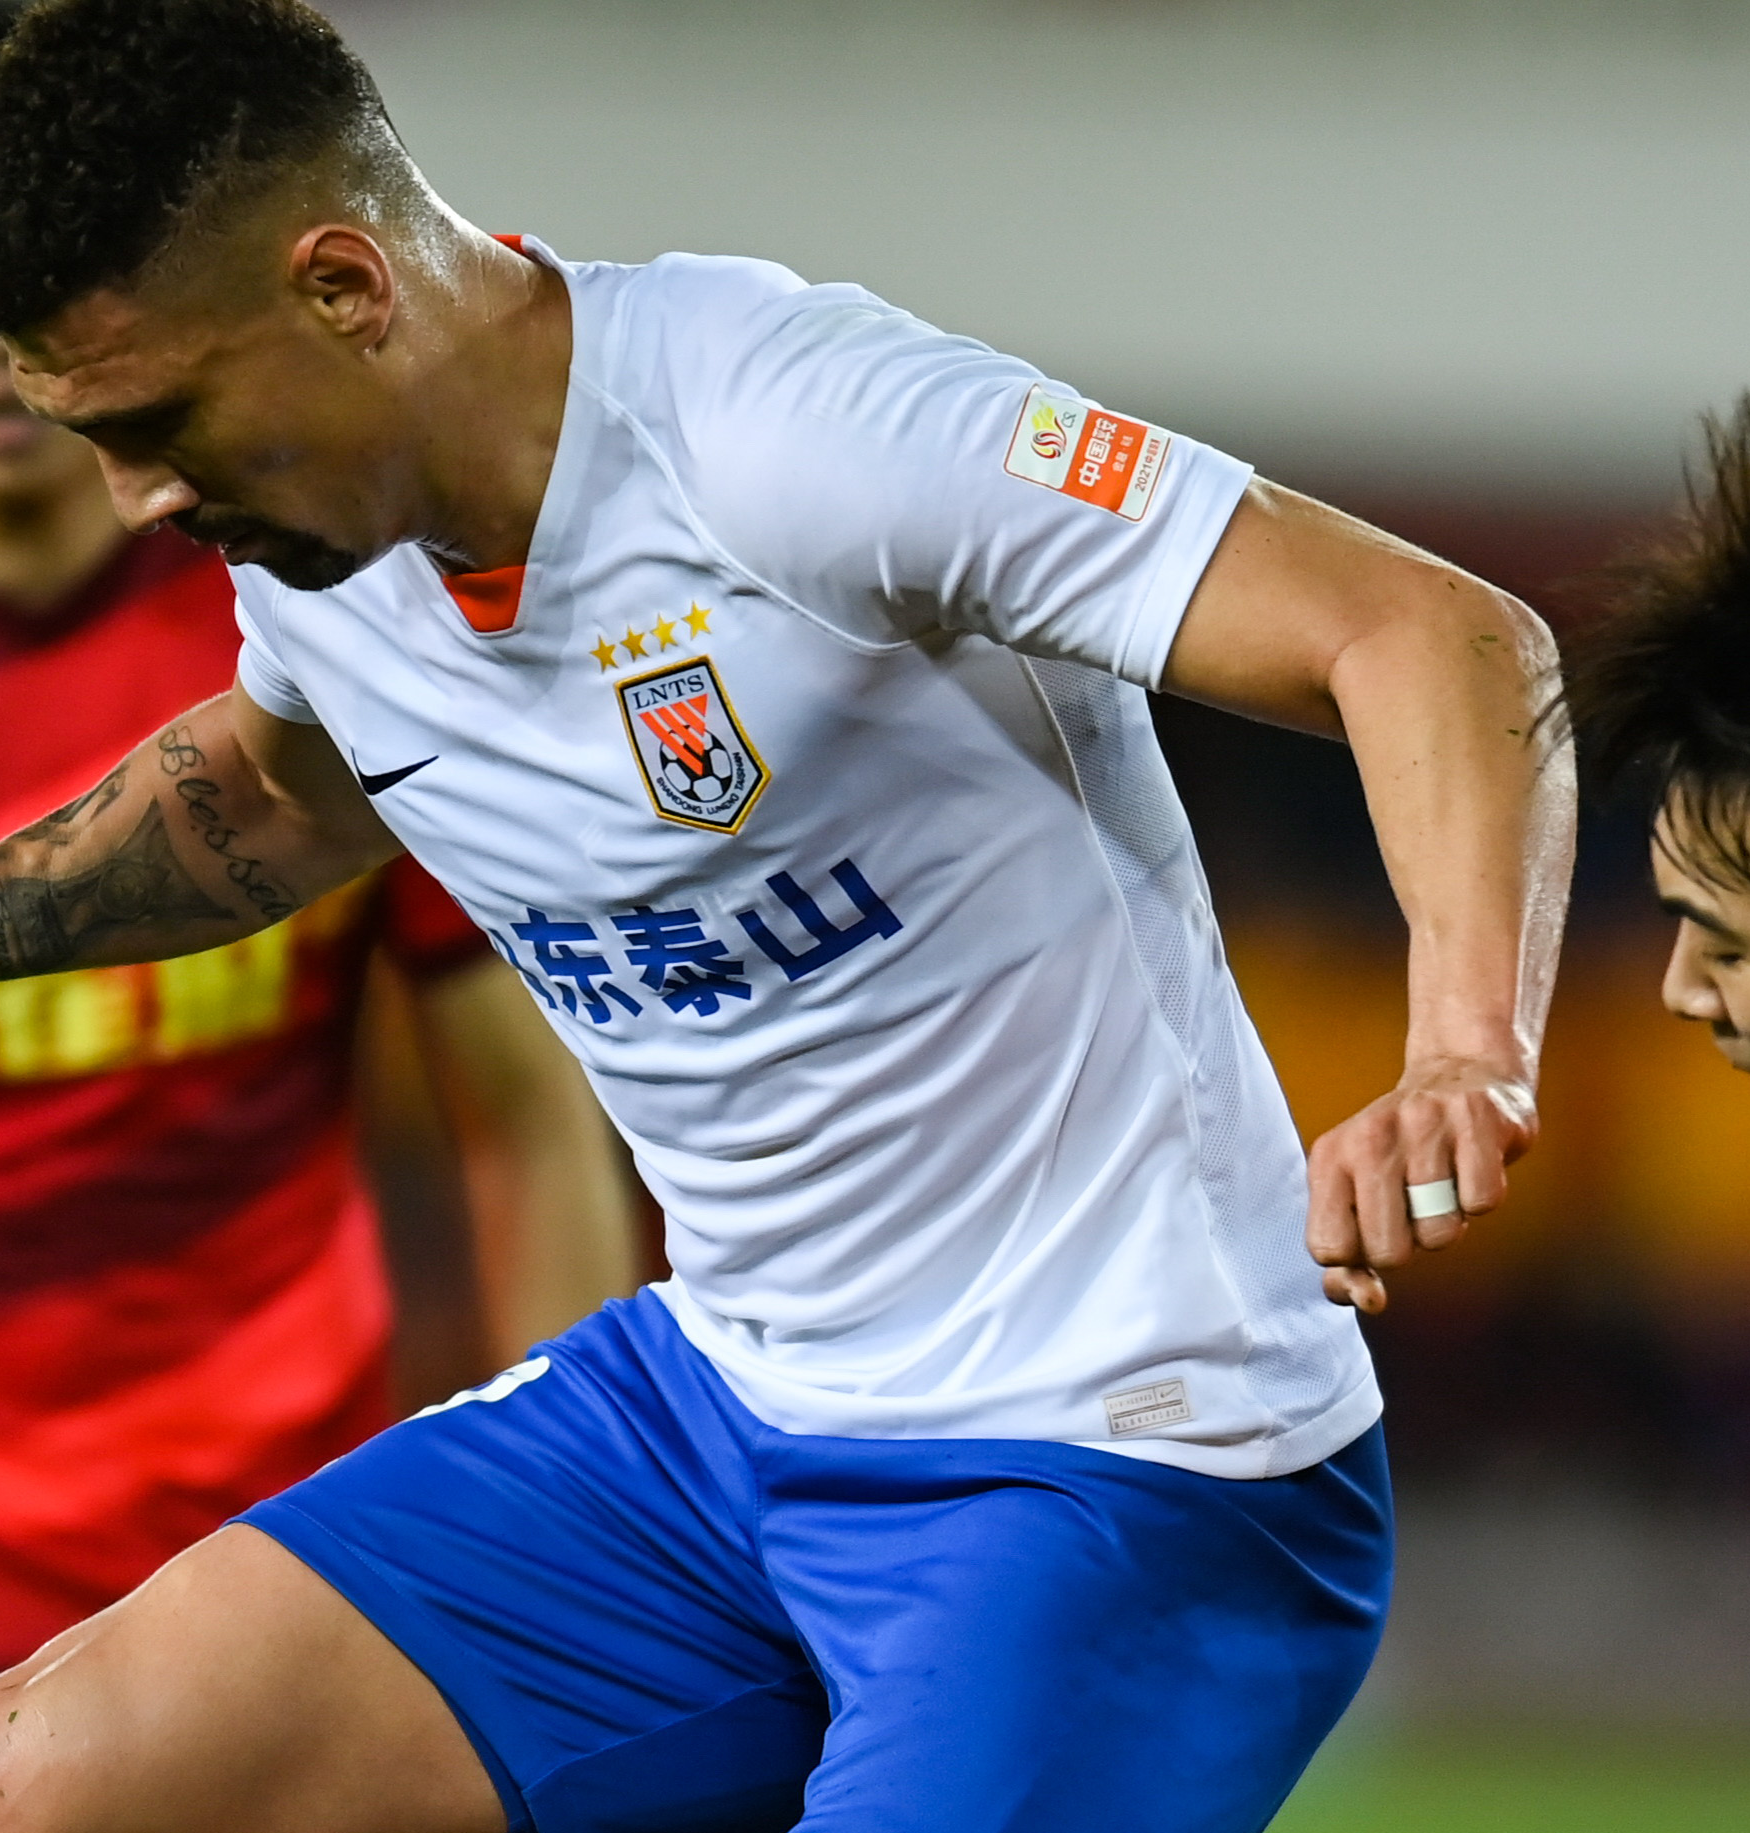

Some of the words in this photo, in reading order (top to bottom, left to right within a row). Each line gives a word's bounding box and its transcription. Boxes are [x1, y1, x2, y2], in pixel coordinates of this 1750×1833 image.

[631, 673, 706, 711] LNTS
[655, 776, 703, 816] SHANDONG
[706, 792, 739, 816] LUNENG
[731, 751, 746, 792] TAISHAN
[488, 857, 904, 1025] 东泰山
